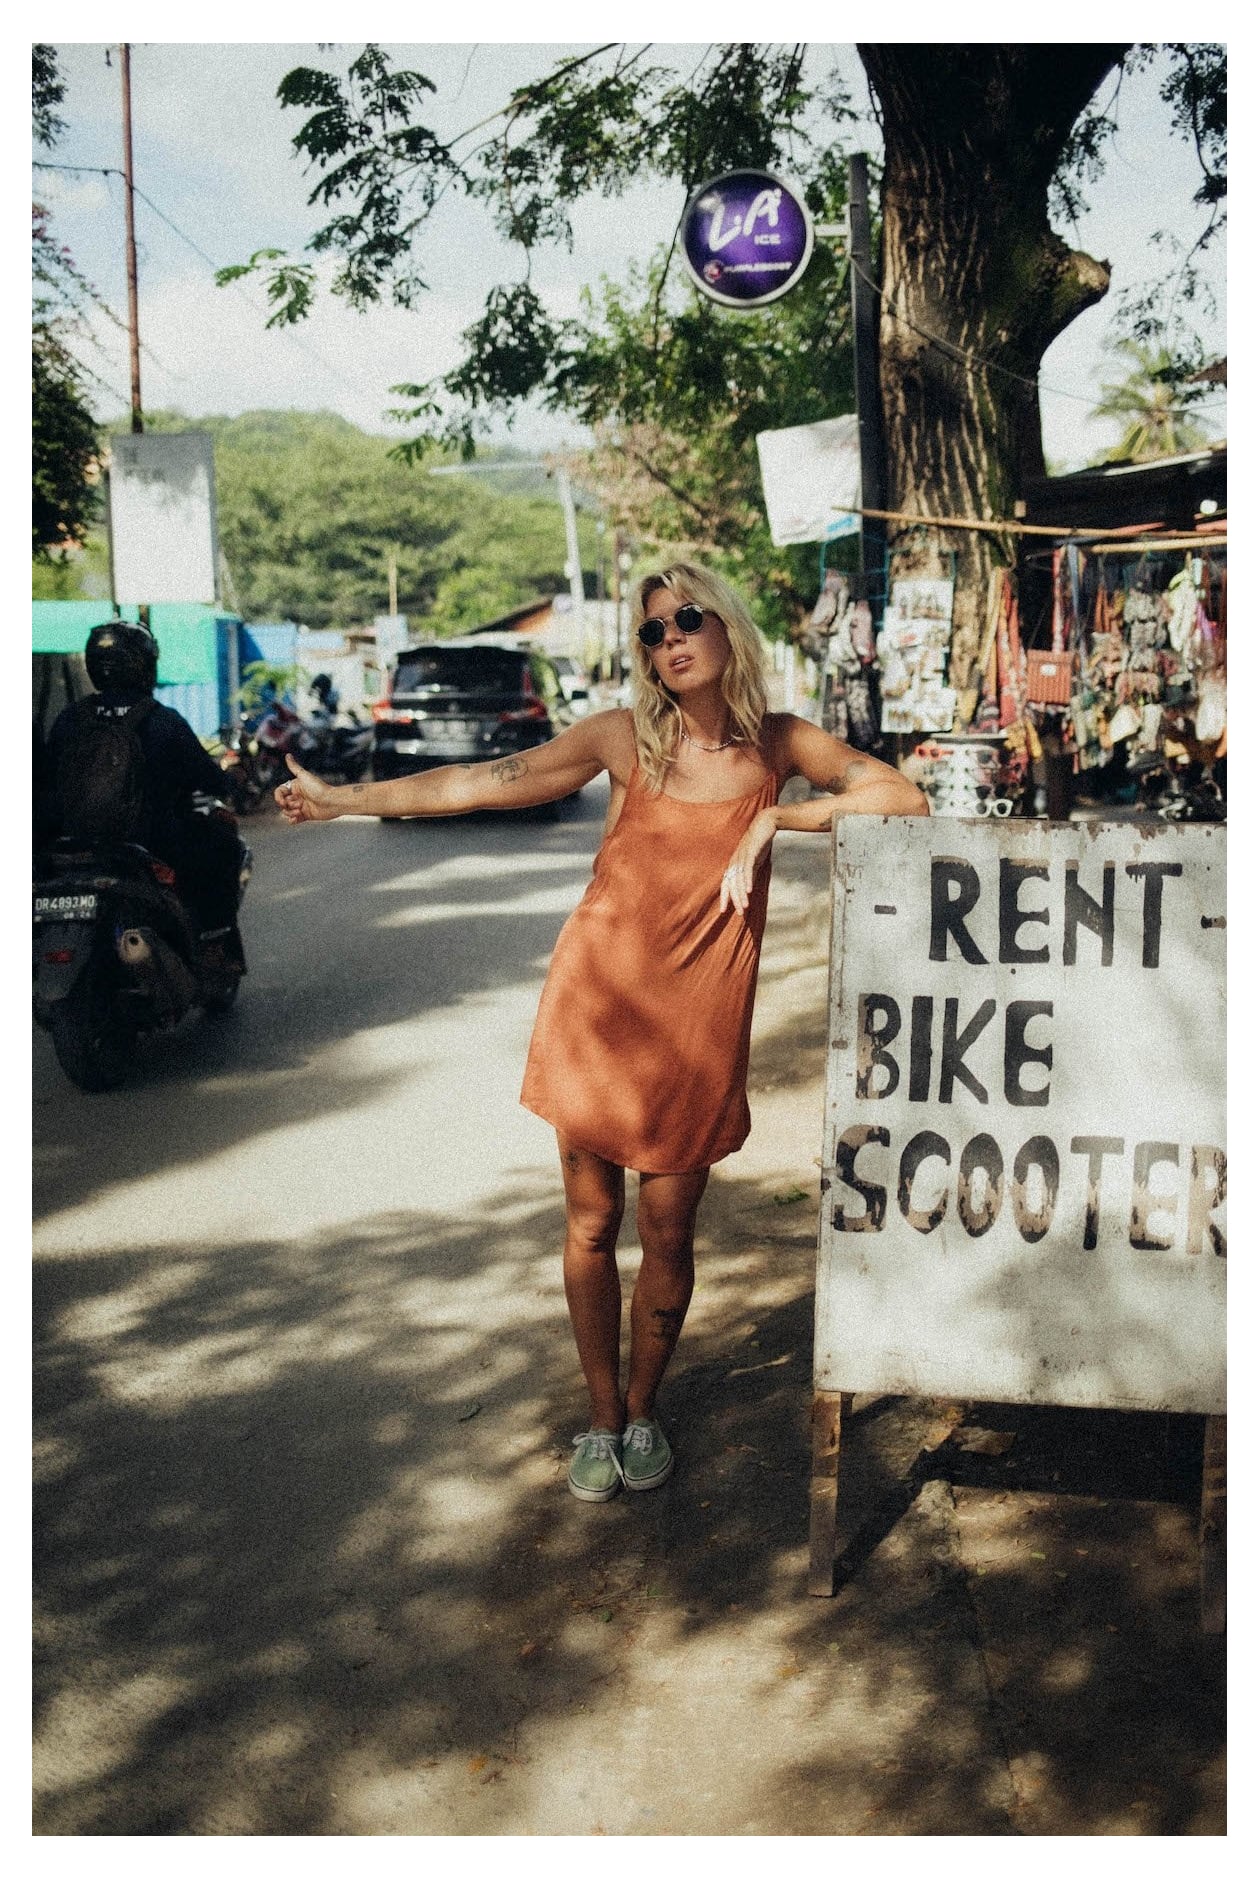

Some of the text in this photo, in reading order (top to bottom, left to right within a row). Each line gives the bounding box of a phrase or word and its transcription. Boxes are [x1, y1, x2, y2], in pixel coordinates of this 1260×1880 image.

[753, 233, 782, 246] ICE
[928, 854, 1183, 969] RENT
[855, 992, 1054, 1108] BIKE
[832, 1124, 1227, 1258] SCOOTER
